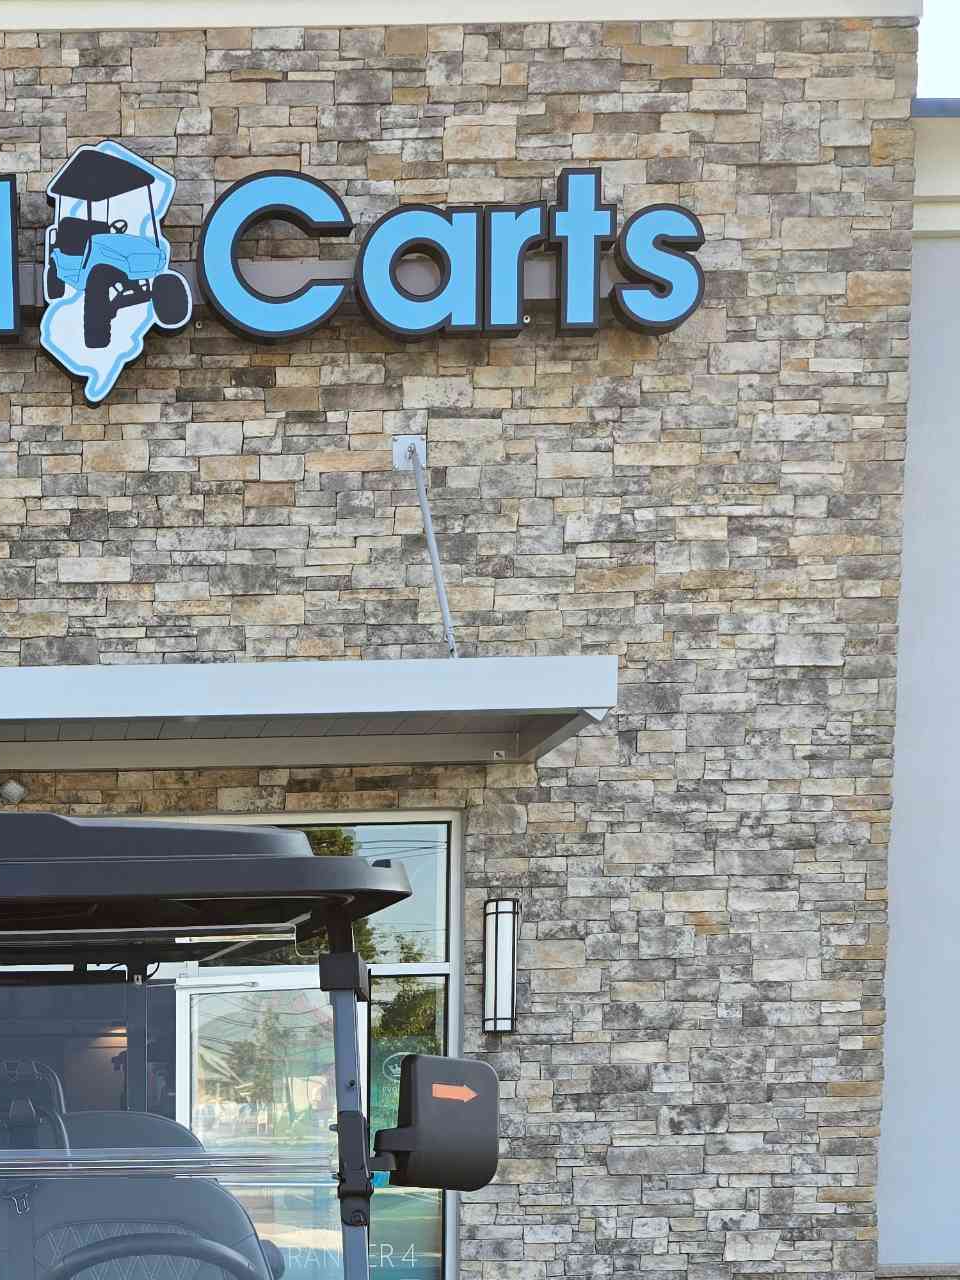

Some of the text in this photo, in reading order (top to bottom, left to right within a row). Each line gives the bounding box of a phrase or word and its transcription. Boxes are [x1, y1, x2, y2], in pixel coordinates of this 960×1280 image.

[197, 167, 706, 342] Carts
[289, 1243, 418, 1269] RANER 4
